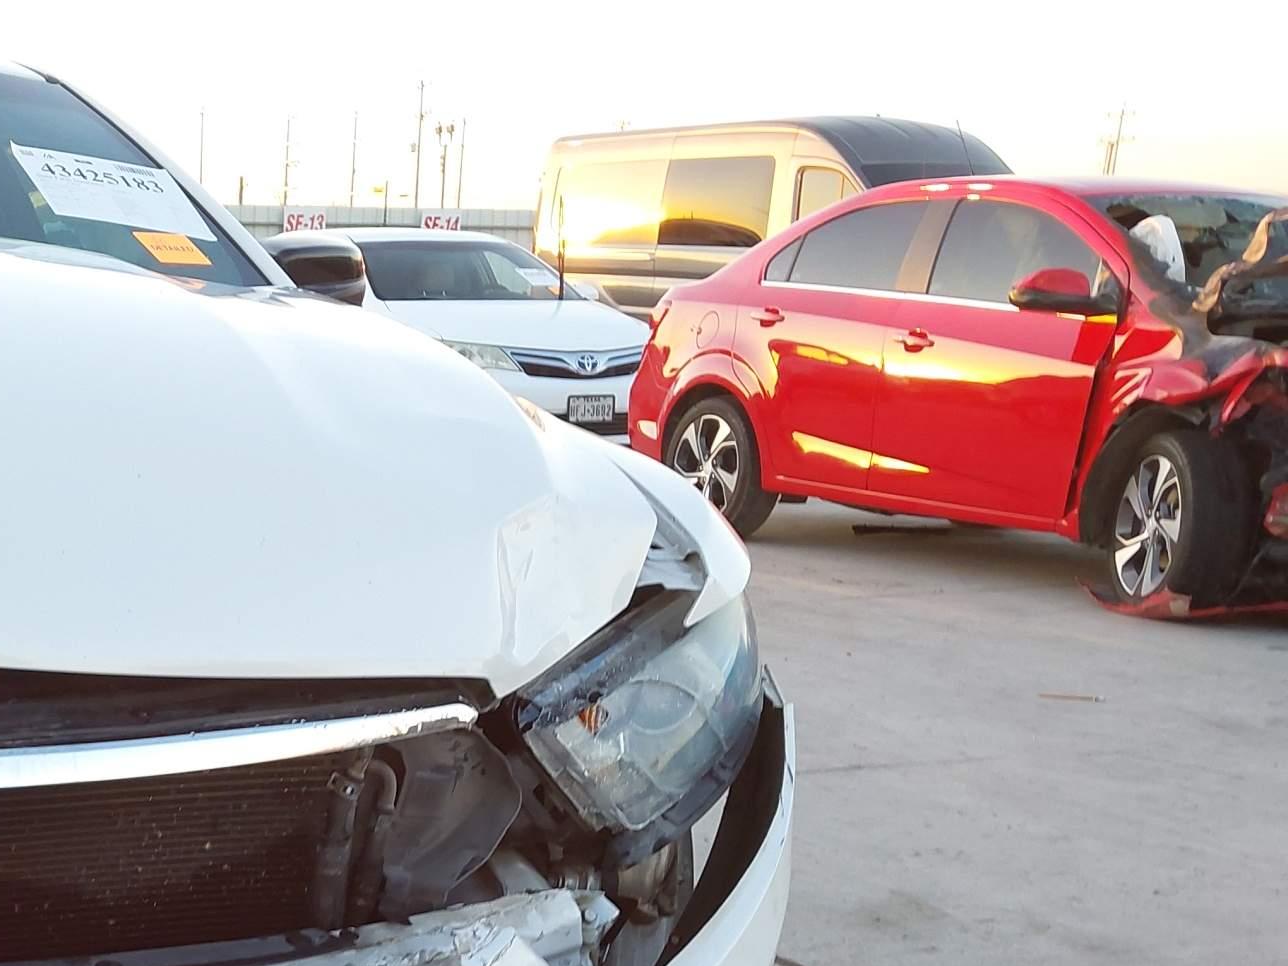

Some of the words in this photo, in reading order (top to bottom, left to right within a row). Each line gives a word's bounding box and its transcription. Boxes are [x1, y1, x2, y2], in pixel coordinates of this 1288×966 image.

[40, 162, 164, 193] 43425183
[285, 213, 325, 232] SF-13
[423, 215, 460, 232] SF-14
